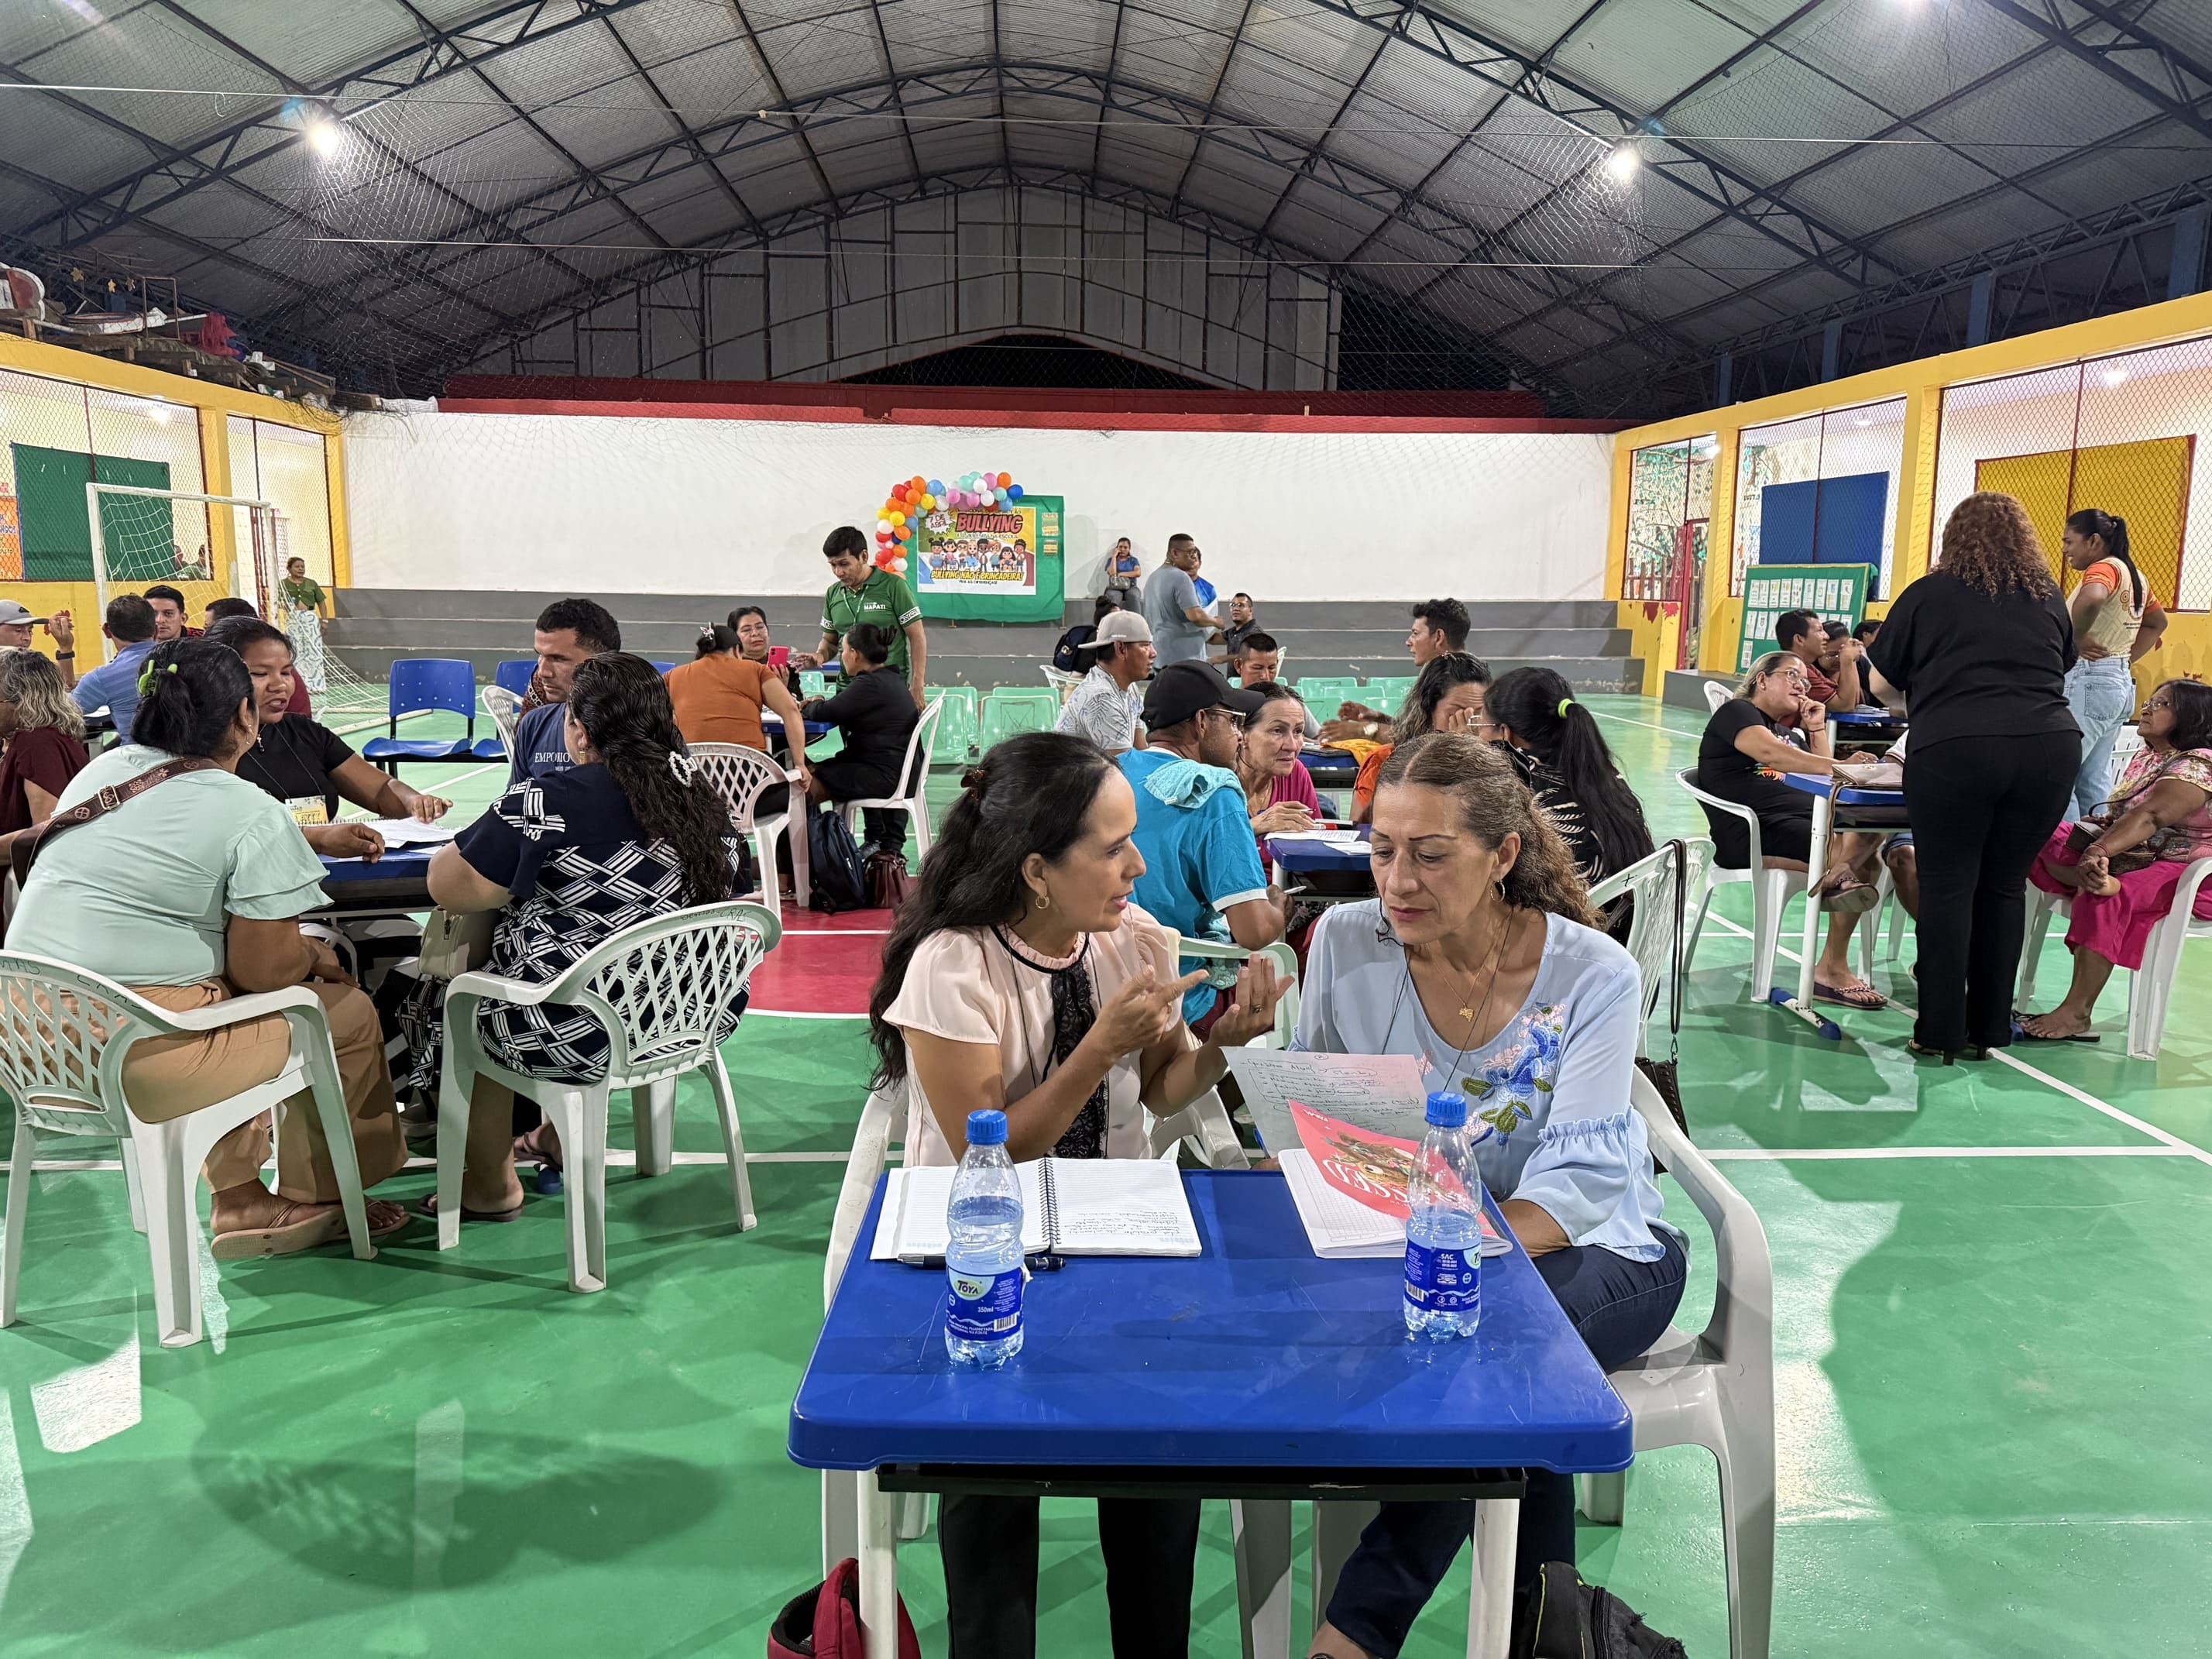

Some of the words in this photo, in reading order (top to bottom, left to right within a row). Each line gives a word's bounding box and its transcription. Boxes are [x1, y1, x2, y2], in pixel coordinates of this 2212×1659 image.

[956, 513, 1023, 533] BULLYING
[931, 570, 960, 579] BULLYING
[961, 568, 975, 579] NÃO
[957, 1279, 979, 1295] TOYA
